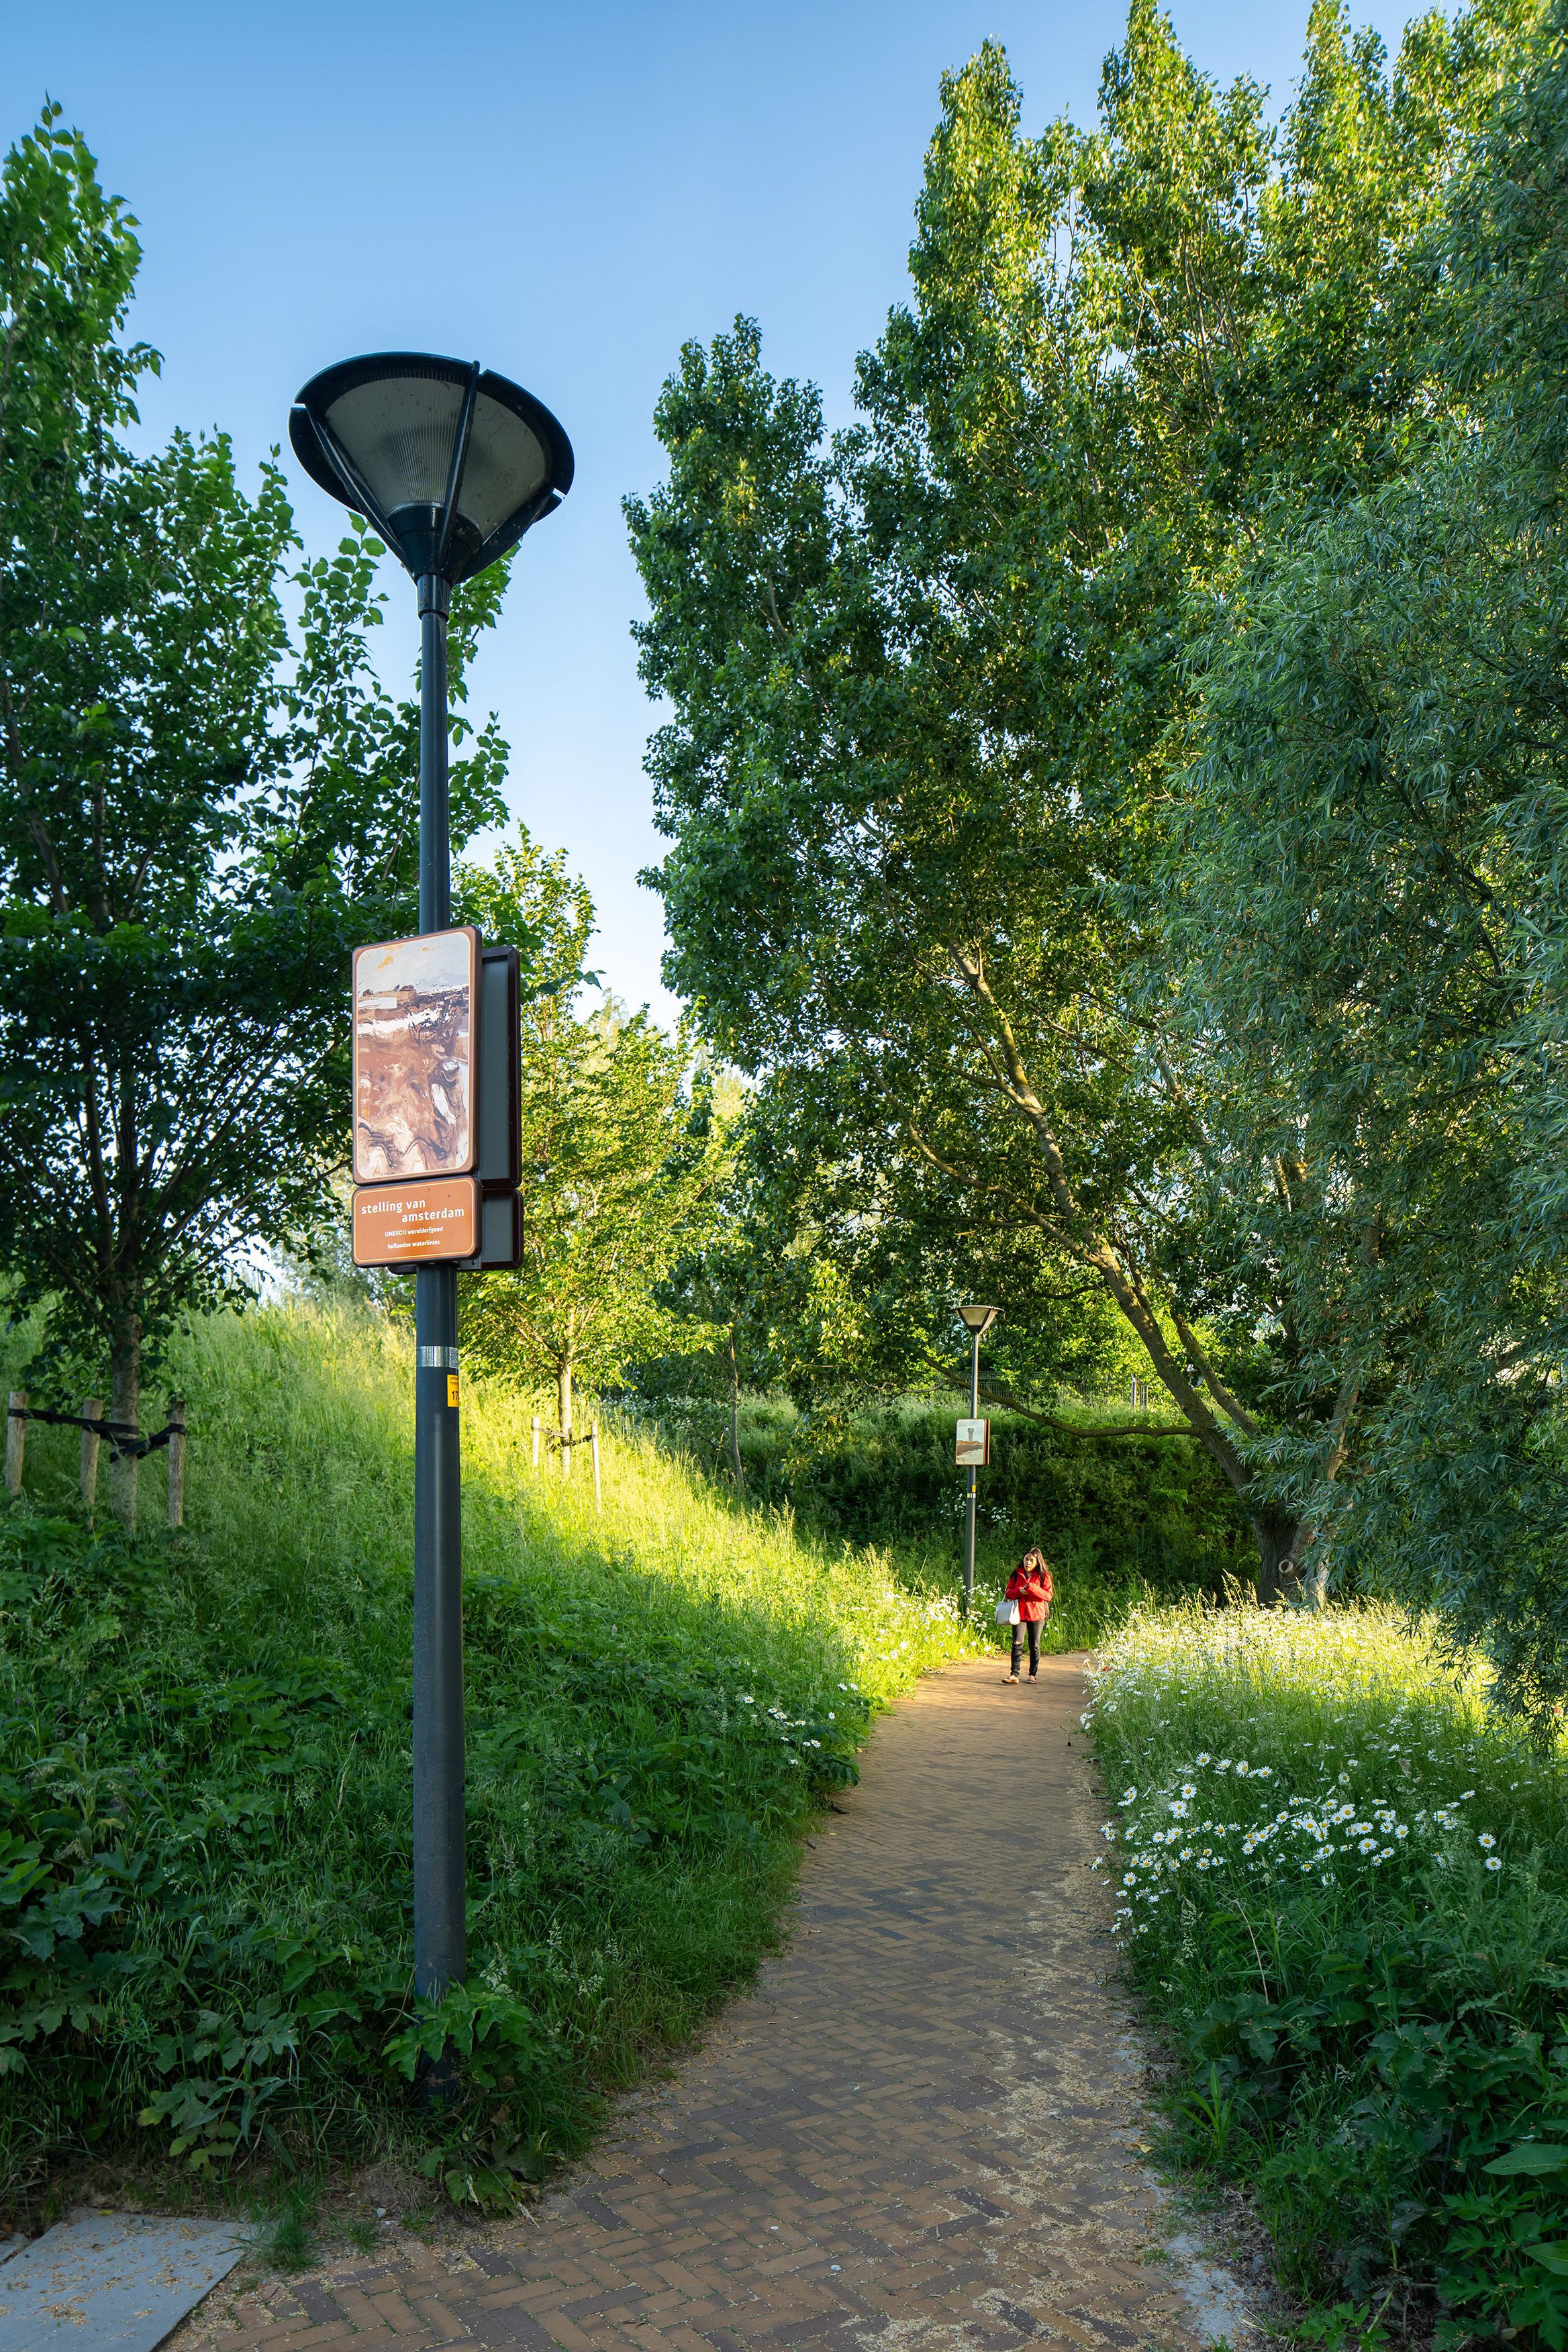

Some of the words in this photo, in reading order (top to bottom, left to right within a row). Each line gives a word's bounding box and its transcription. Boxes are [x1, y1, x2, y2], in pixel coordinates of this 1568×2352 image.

[361, 1201, 403, 1214] stelling
[405, 1199, 426, 1210] van
[401, 1208, 464, 1223] amsterdam
[407, 1226, 444, 1234] werelderfgoed
